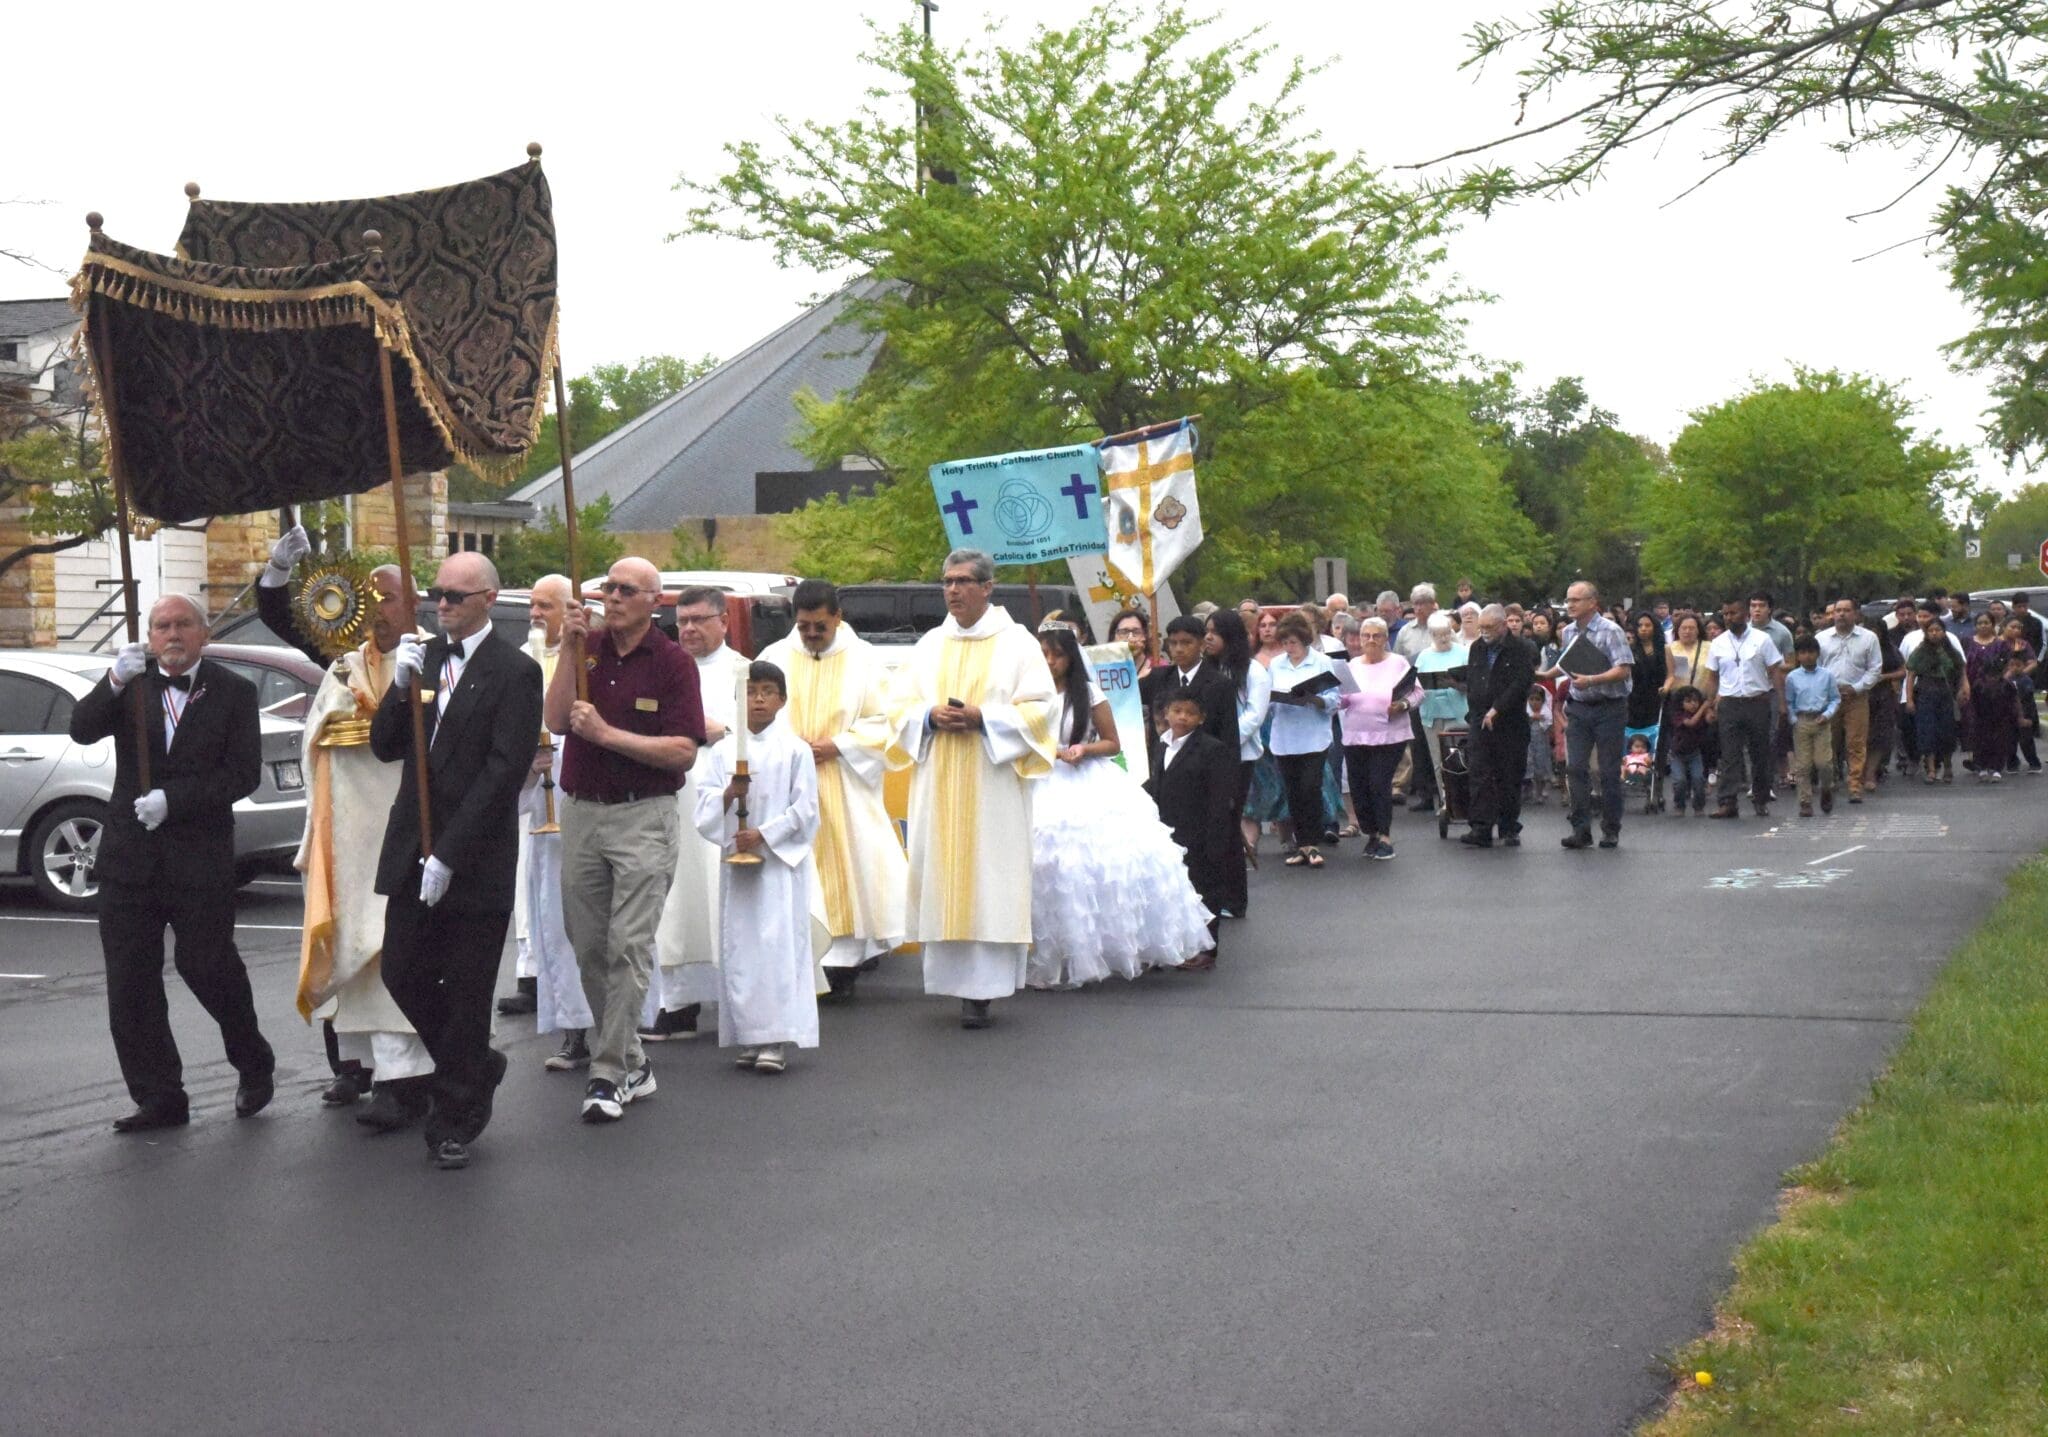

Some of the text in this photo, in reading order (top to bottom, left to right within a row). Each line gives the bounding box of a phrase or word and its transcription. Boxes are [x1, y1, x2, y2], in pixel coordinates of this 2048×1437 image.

[941, 448, 1084, 476] Holy Trinity Catholic Church
[1025, 551, 1038, 560] de
[1096, 668, 1132, 691] ERD
